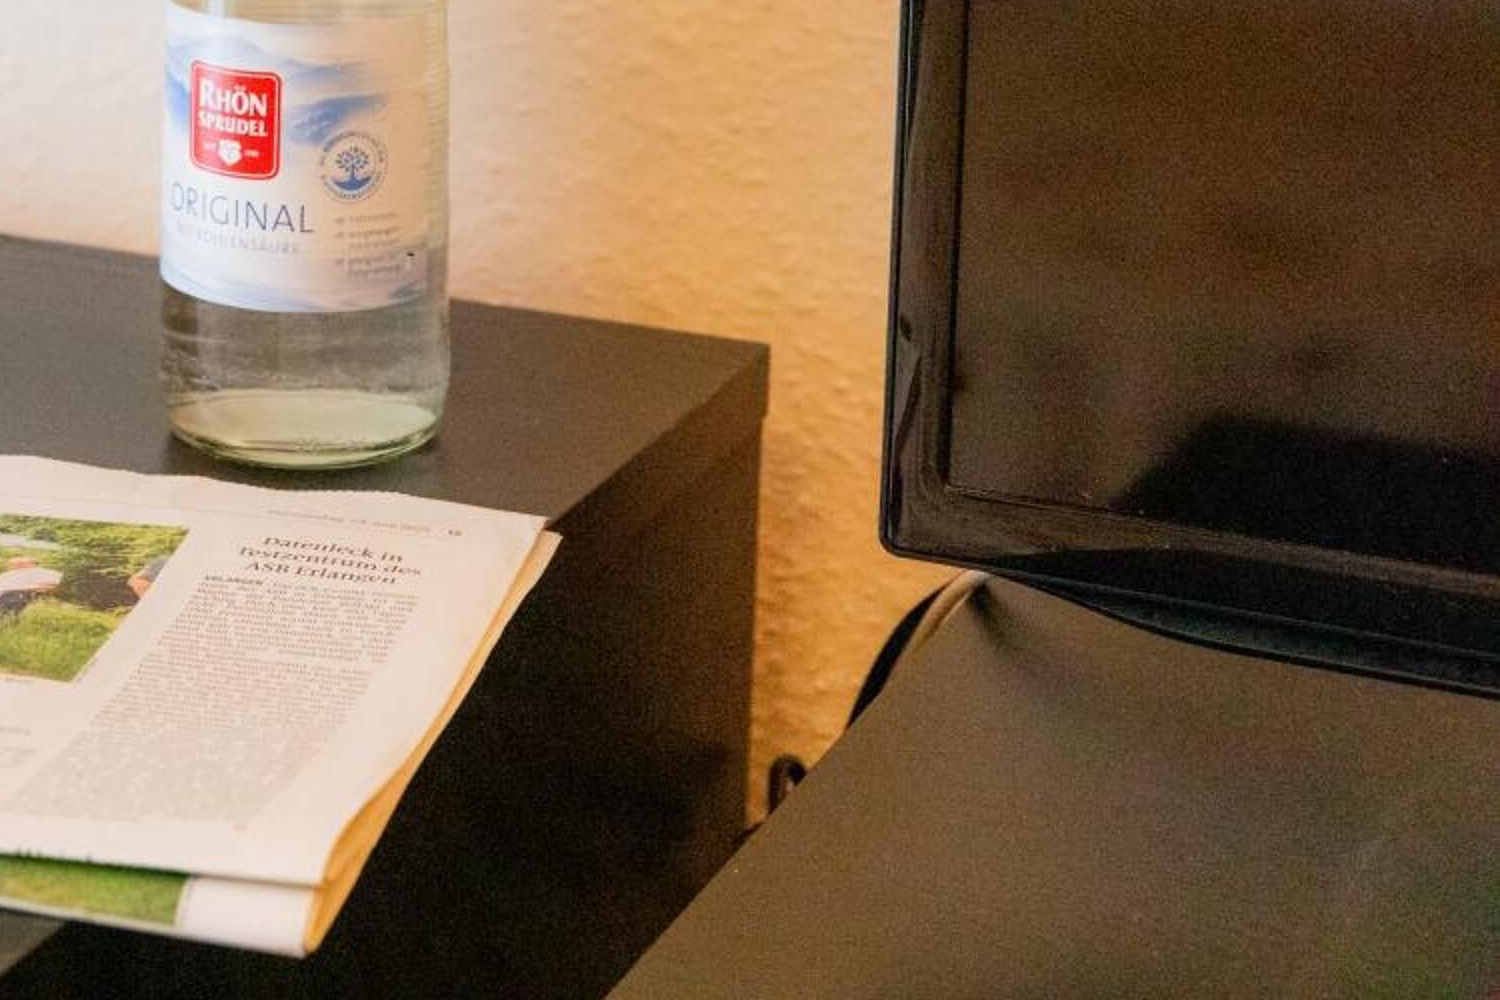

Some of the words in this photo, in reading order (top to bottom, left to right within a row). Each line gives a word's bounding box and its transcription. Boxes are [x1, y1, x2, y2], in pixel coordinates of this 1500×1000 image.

[199, 78, 267, 117] RHÖN
[198, 109, 268, 137] SPRUDEL
[169, 181, 316, 234] ORIGINAL
[238, 546, 378, 572] Testzentrum
[383, 560, 422, 576] des
[263, 536, 374, 560] Datenleck
[380, 551, 404, 563] in
[296, 566, 398, 586] Erlangen
